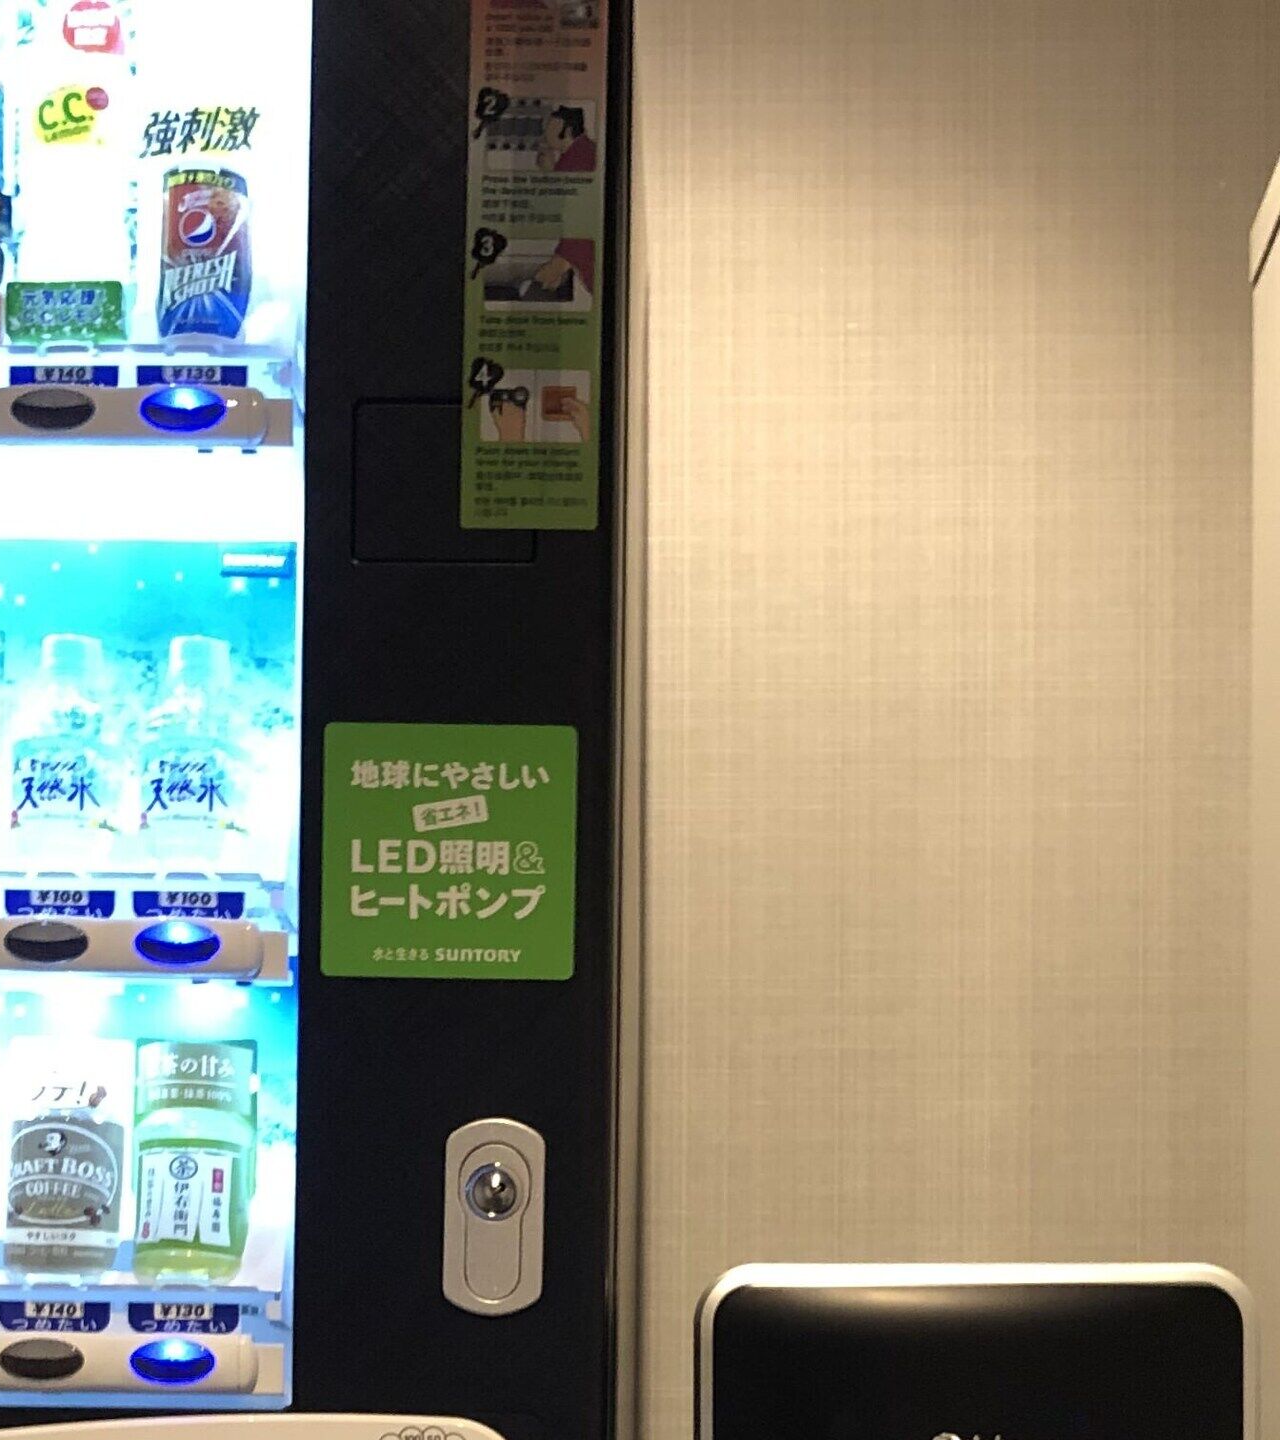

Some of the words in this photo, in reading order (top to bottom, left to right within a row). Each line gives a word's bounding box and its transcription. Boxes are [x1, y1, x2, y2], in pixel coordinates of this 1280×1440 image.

[139, 106, 261, 159] 強刺激
[475, 363, 493, 388] 4
[351, 759, 550, 790] 地球にやさしい
[421, 801, 483, 827] 省エネ!
[351, 882, 546, 920] ヒートポンプ
[435, 948, 522, 963] SUNTORY
[61, 1157, 112, 1186] BOSS
[12, 1318, 97, 1331] つめたい
[141, 1319, 226, 1332] つめたい
